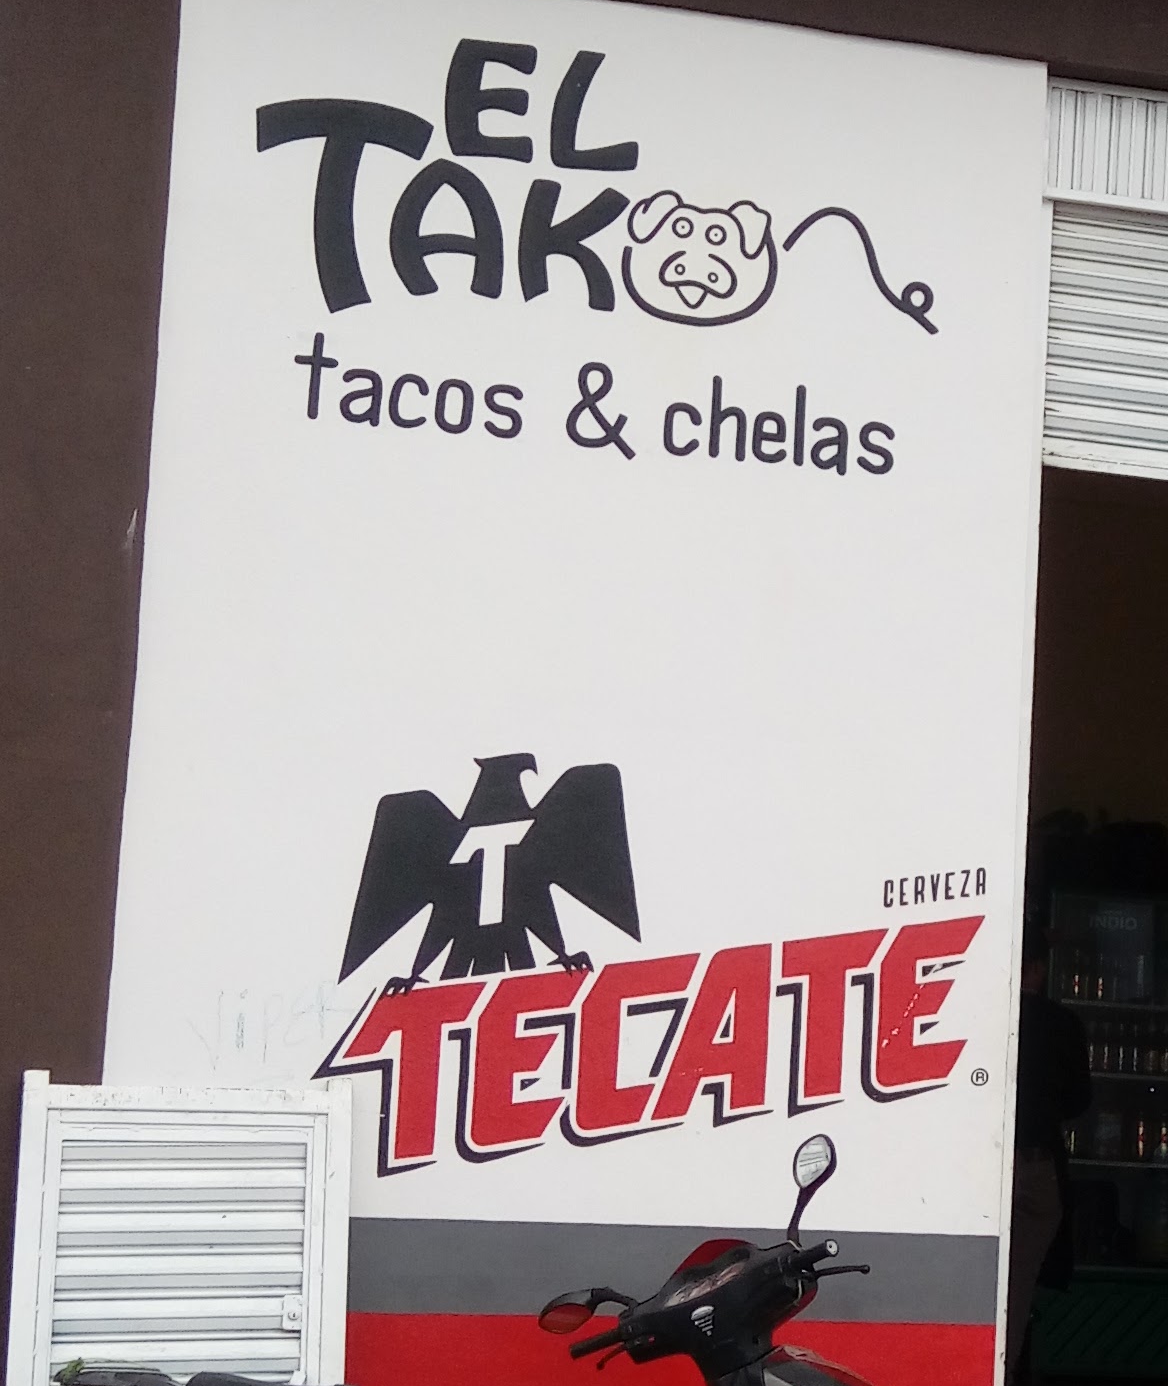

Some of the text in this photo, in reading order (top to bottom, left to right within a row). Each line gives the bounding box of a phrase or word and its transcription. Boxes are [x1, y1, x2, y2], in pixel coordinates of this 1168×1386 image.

[444, 38, 639, 171] EL
[294, 332, 895, 476] tacos & chelas
[449, 819, 534, 925] T
[883, 867, 987, 908] CERVEZA
[1089, 915, 1137, 931] INDIO
[310, 915, 985, 1177] TECATE
